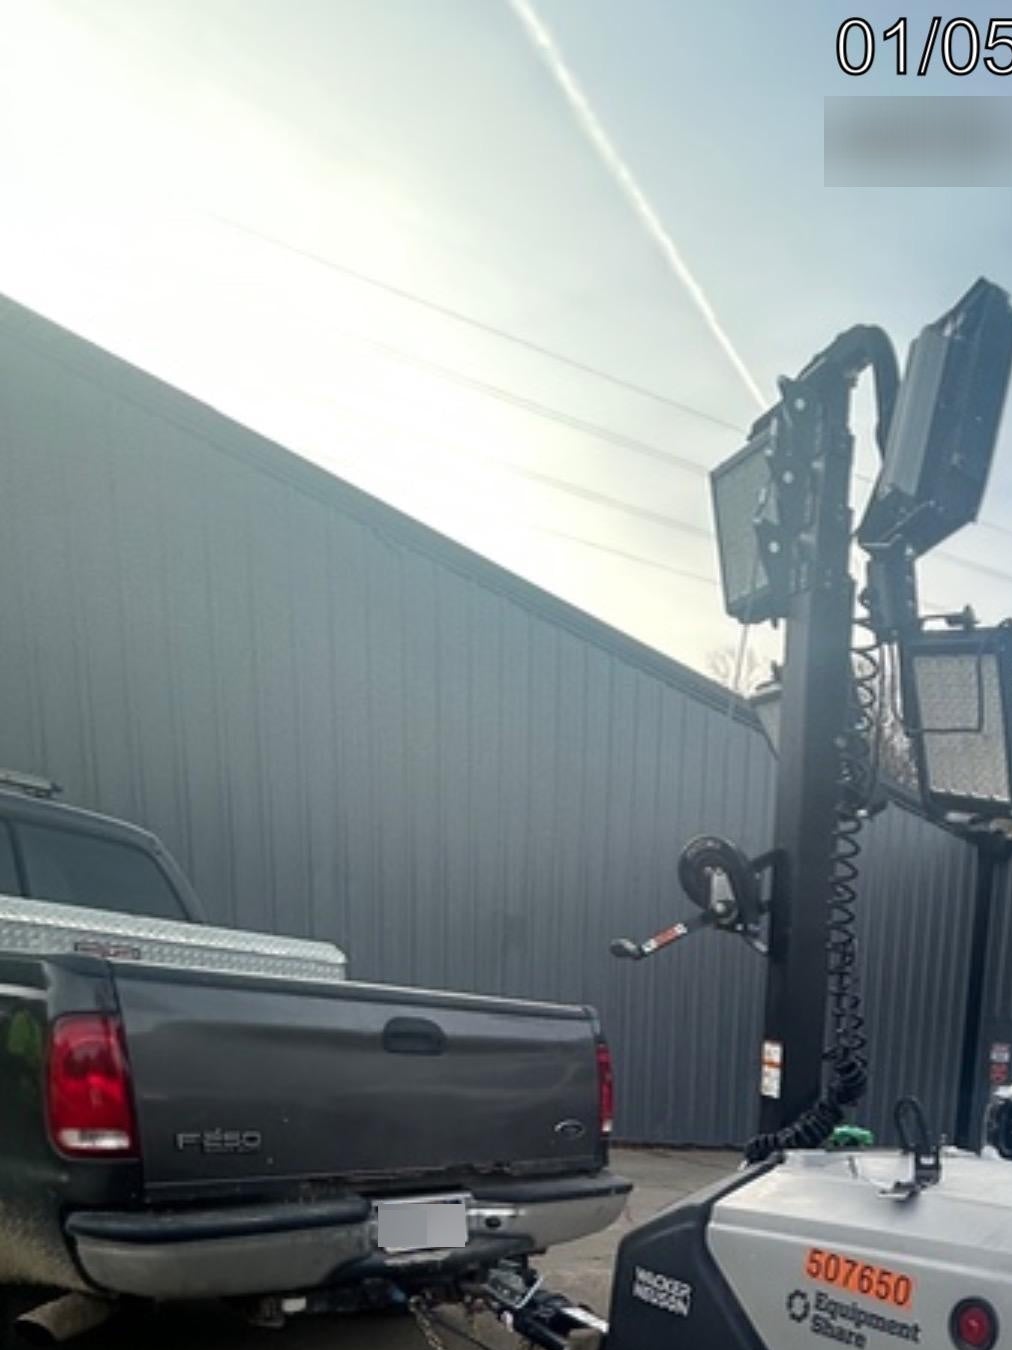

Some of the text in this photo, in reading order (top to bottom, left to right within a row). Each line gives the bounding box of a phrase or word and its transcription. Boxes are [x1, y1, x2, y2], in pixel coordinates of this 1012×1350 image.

[807, 1247, 912, 1306] 507650
[809, 1313, 867, 1350] Share
[814, 1289, 921, 1344] Equipment
